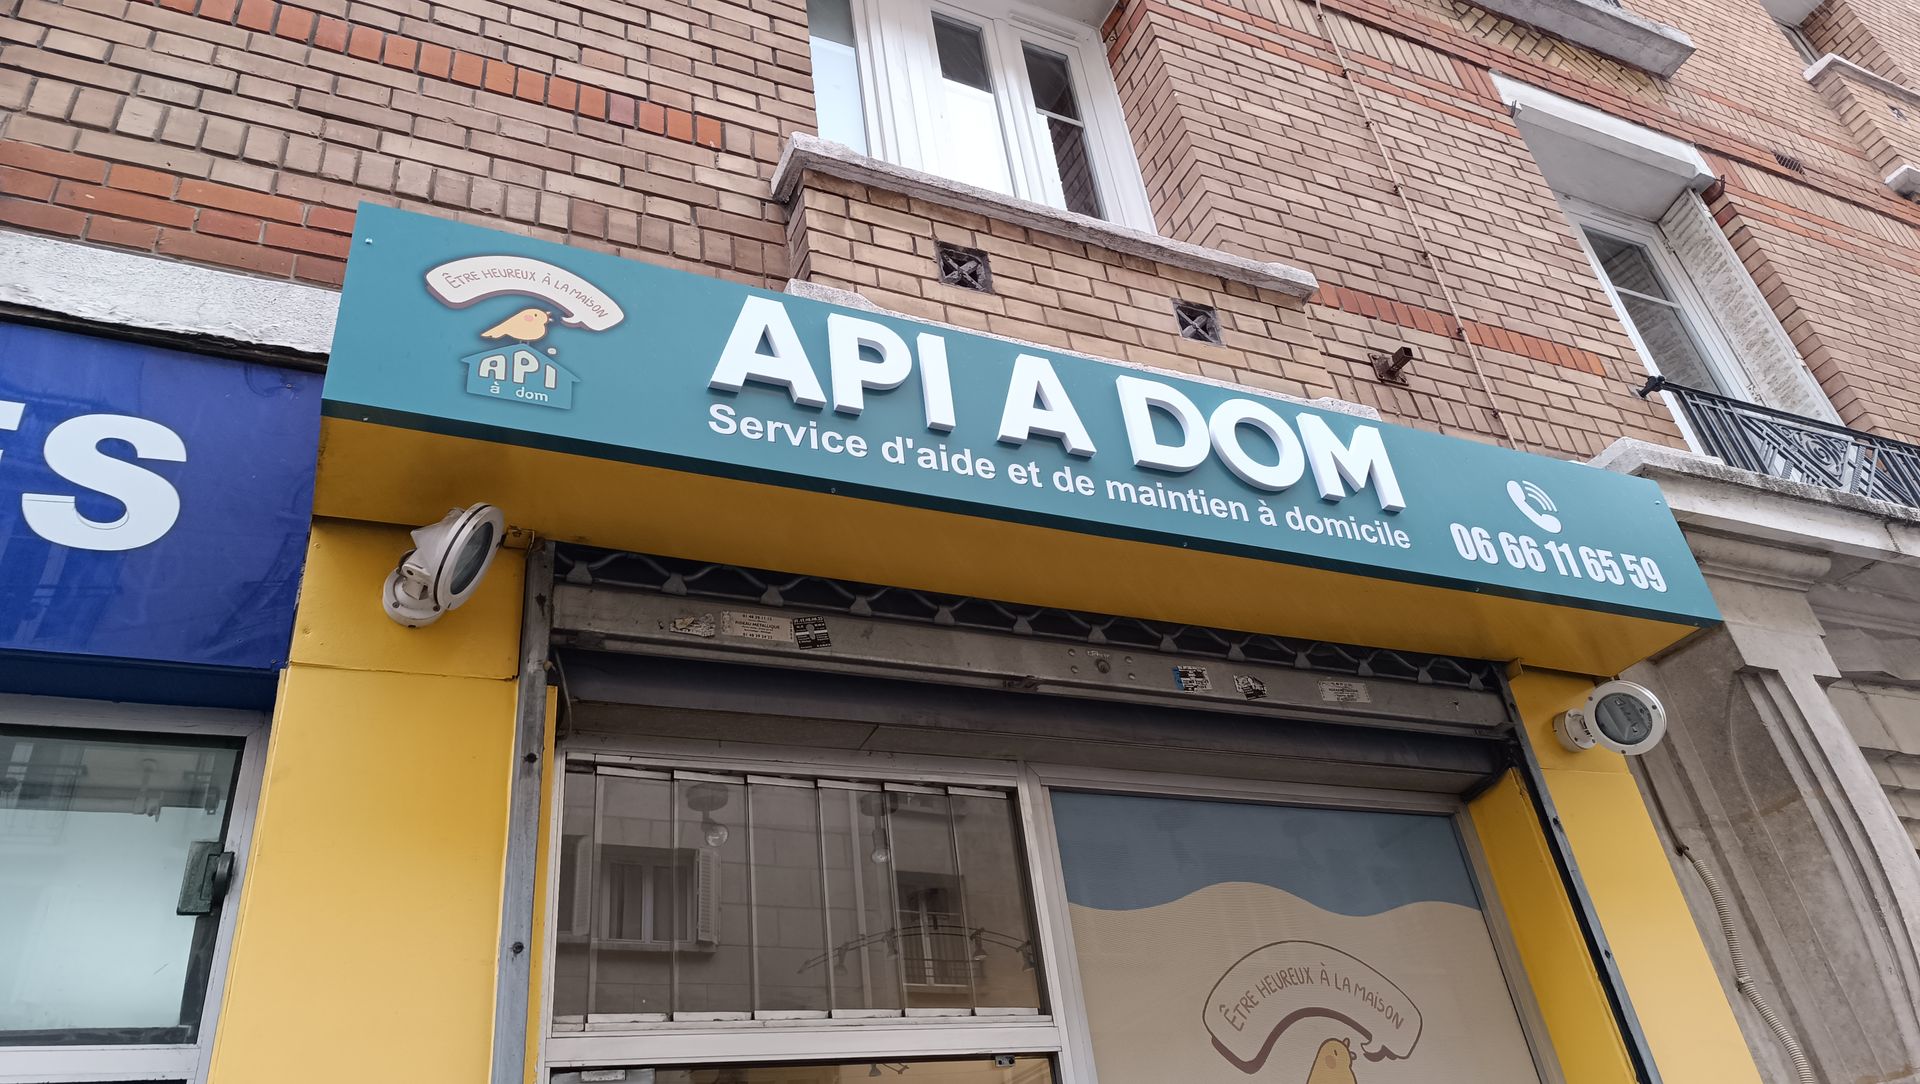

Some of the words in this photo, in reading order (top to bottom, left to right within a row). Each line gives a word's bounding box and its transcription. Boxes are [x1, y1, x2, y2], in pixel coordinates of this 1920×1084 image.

[442, 270, 480, 289] ÊTRE
[481, 268, 536, 282] HEUREUX
[542, 272, 551, 286] À
[554, 280, 569, 293] LA
[490, 381, 500, 394] à
[515, 387, 548, 402] dom
[708, 295, 956, 432] API
[997, 353, 1097, 458] A
[1115, 375, 1406, 512] DOM
[708, 403, 868, 457] Service
[881, 436, 996, 479] d'aide
[1008, 461, 1043, 488] et
[1052, 466, 1095, 496] de
[1105, 479, 1249, 522] maintien
[1258, 499, 1278, 527] à
[1285, 506, 1411, 549] domicile
[1450, 522, 1499, 565] 06
[1498, 531, 1547, 573] 66
[1544, 540, 1582, 579] 11
[1578, 545, 1625, 586] 65
[1620, 553, 1667, 593] 59
[1219, 990, 1260, 1032] ÊTRE
[1255, 967, 1314, 999] HEUREUX
[1320, 962, 1331, 987] À
[1334, 972, 1351, 993] LA
